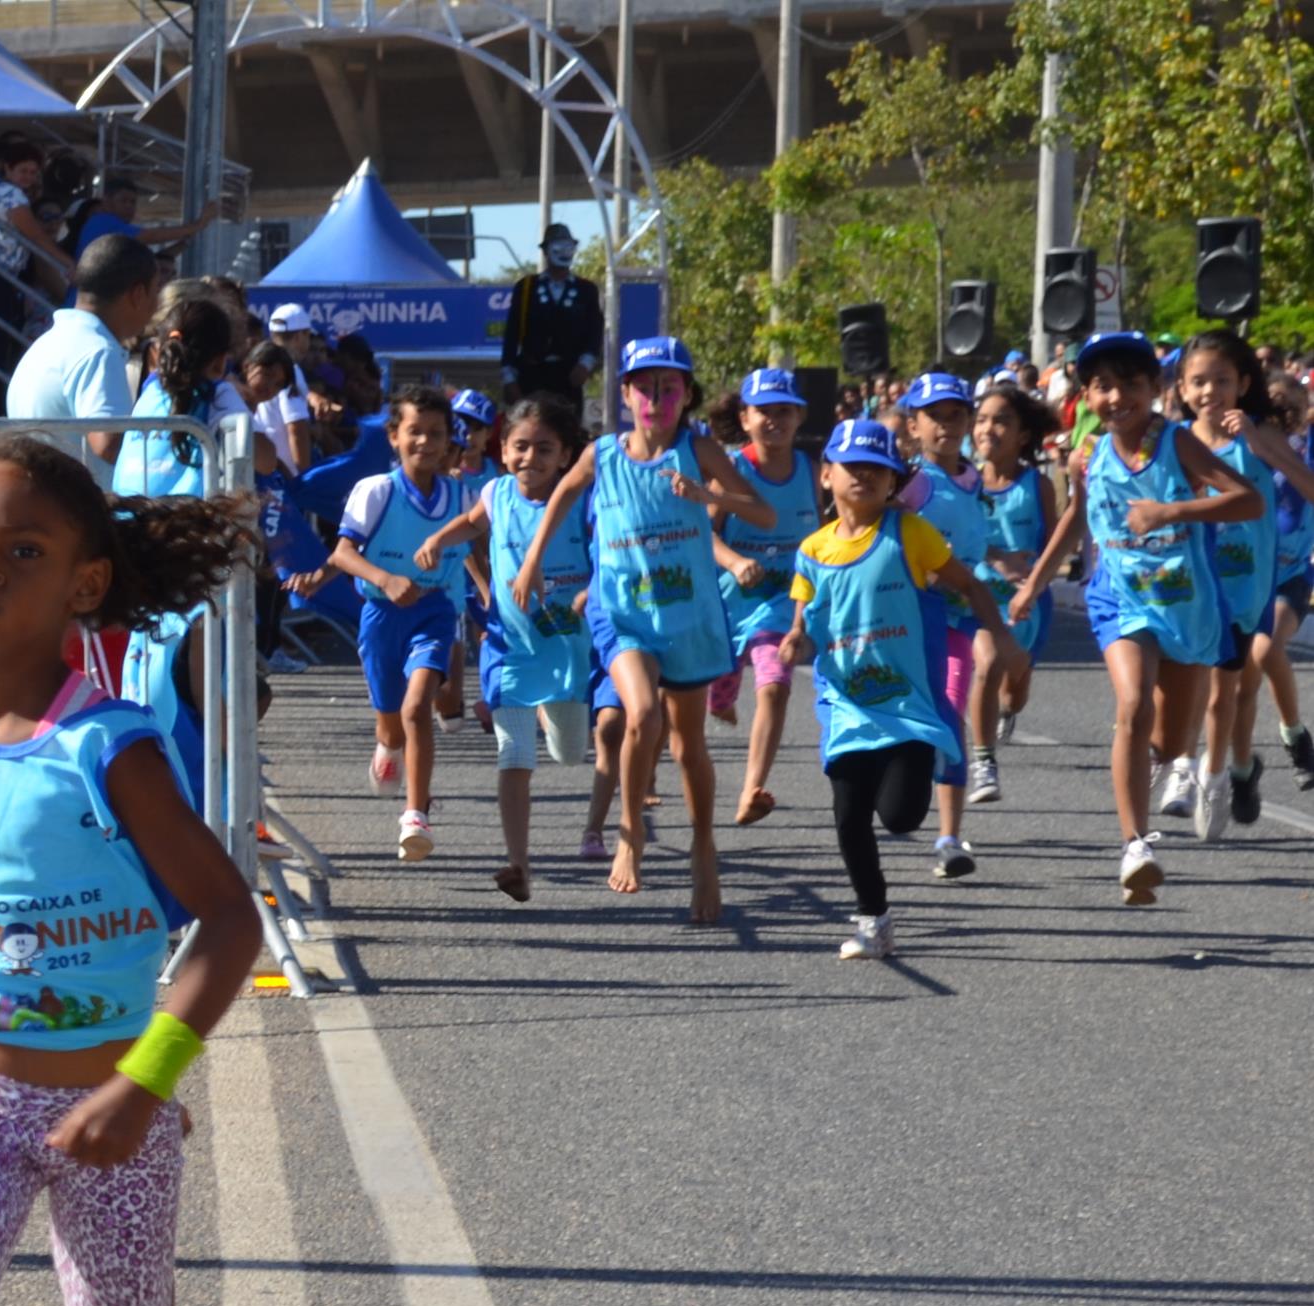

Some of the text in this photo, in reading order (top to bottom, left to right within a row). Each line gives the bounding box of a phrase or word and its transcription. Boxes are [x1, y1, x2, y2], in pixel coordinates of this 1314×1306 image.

[15, 896, 74, 914] CAIXA
[79, 888, 102, 906] DE
[47, 951, 91, 971] 2012
